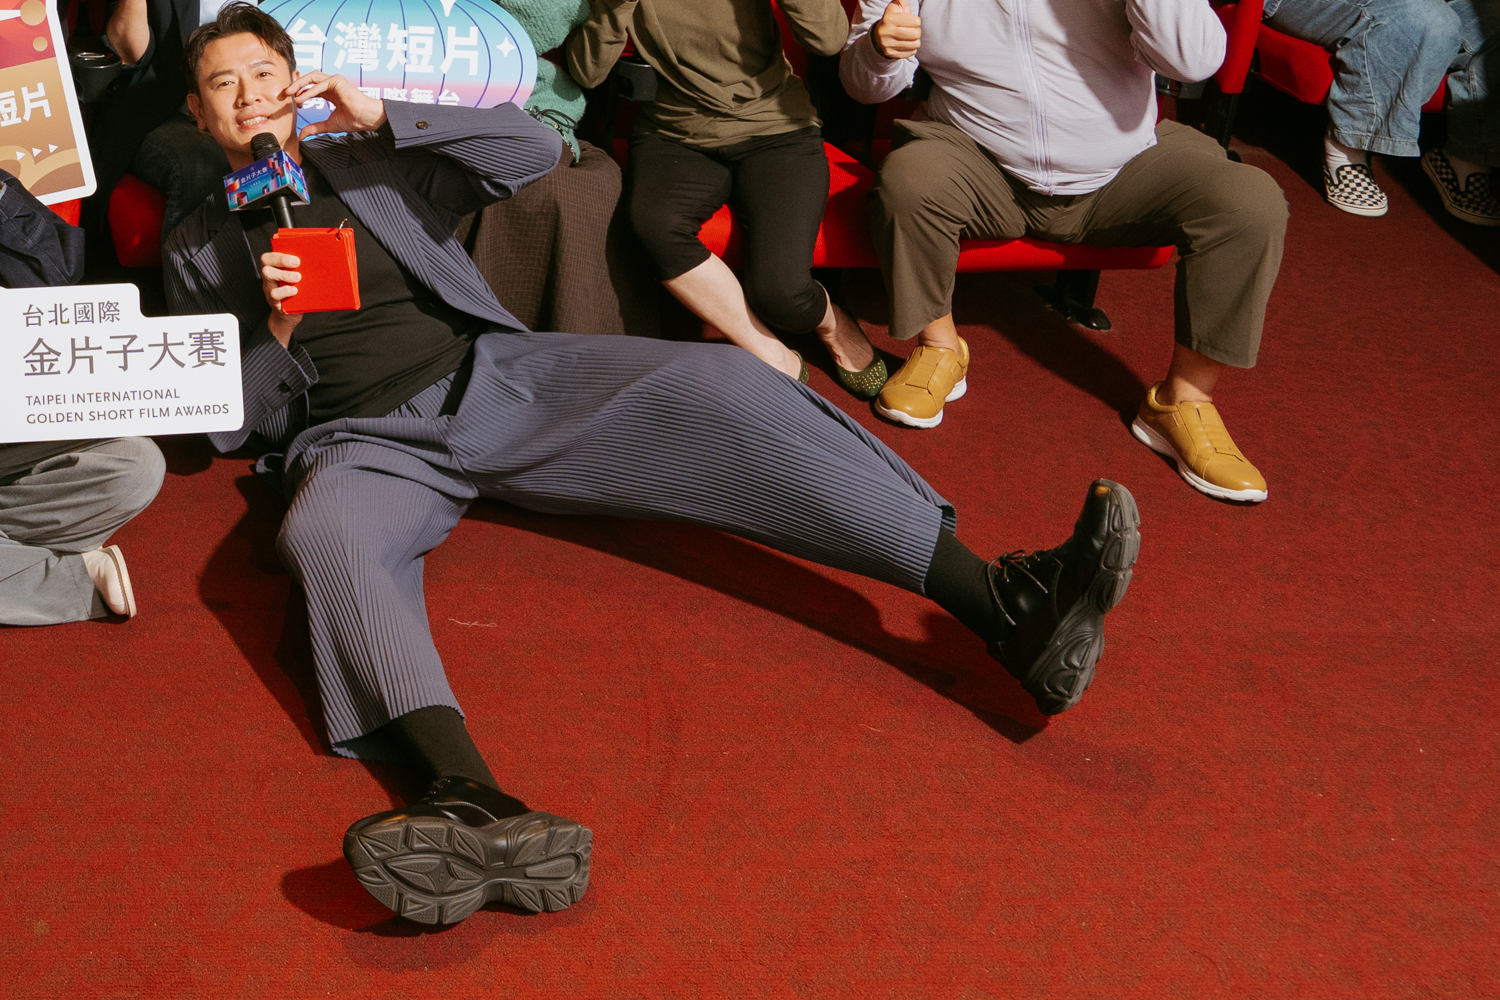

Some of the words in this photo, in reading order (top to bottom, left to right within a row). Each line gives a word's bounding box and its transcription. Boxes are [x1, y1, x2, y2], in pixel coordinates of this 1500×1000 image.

[287, 18, 479, 76] 台灣短片
[23, 300, 120, 327] 台北國際
[23, 328, 227, 376] 金片子大賽
[25, 394, 66, 406] TAIPEI
[71, 388, 180, 403] INTERNATIONAL
[26, 411, 84, 424] GOLDEN
[89, 409, 134, 421] SHORT
[139, 407, 170, 418] FILM
[175, 403, 229, 417] AWARDS
